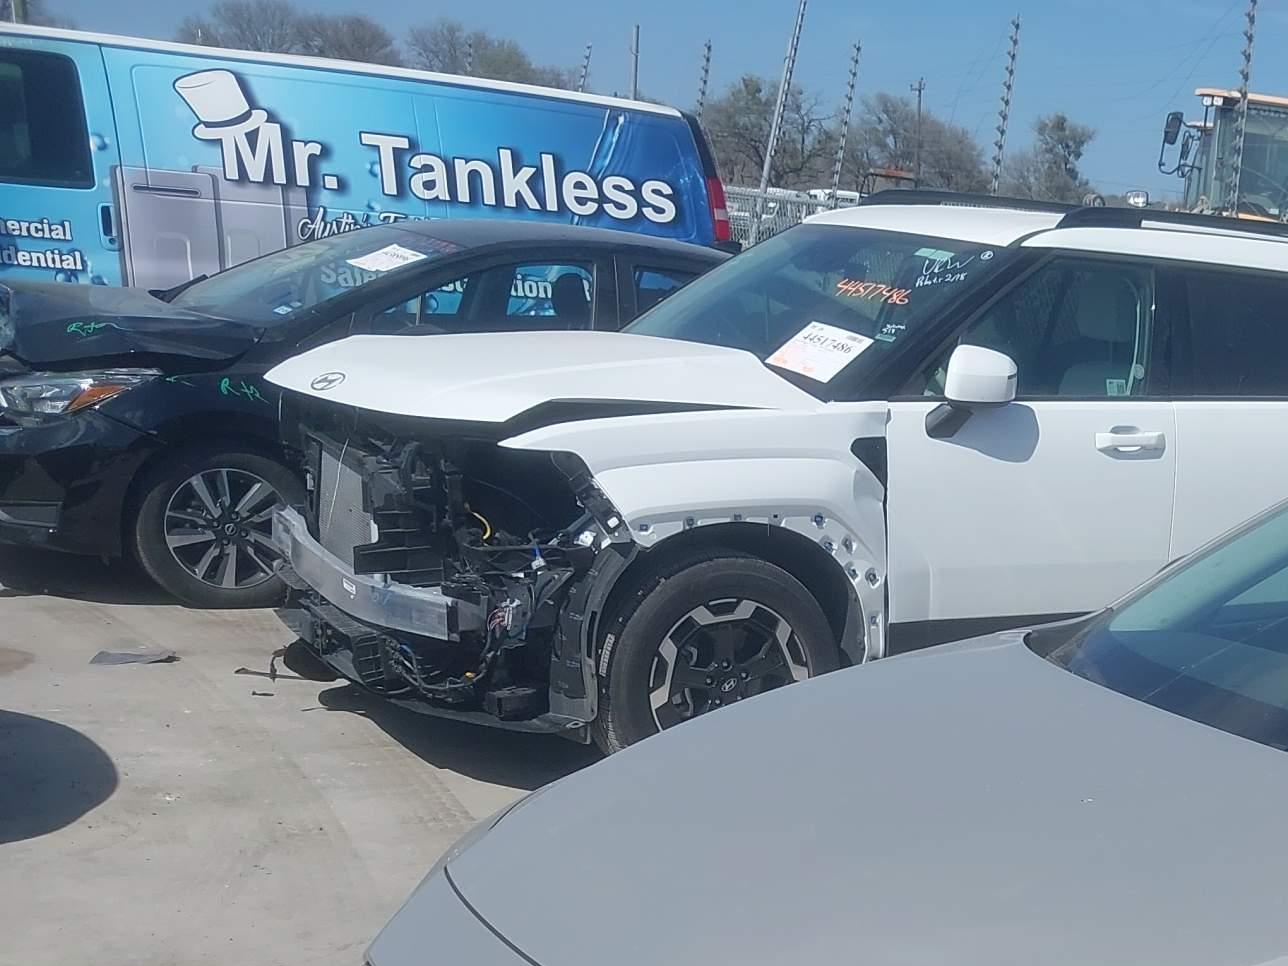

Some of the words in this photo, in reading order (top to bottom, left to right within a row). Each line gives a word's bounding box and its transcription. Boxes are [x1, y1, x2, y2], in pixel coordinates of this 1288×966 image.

[220, 122, 338, 191] Mr.
[359, 131, 677, 223] Tankless
[835, 278, 912, 305] 44517486
[802, 332, 855, 354] 44517486
